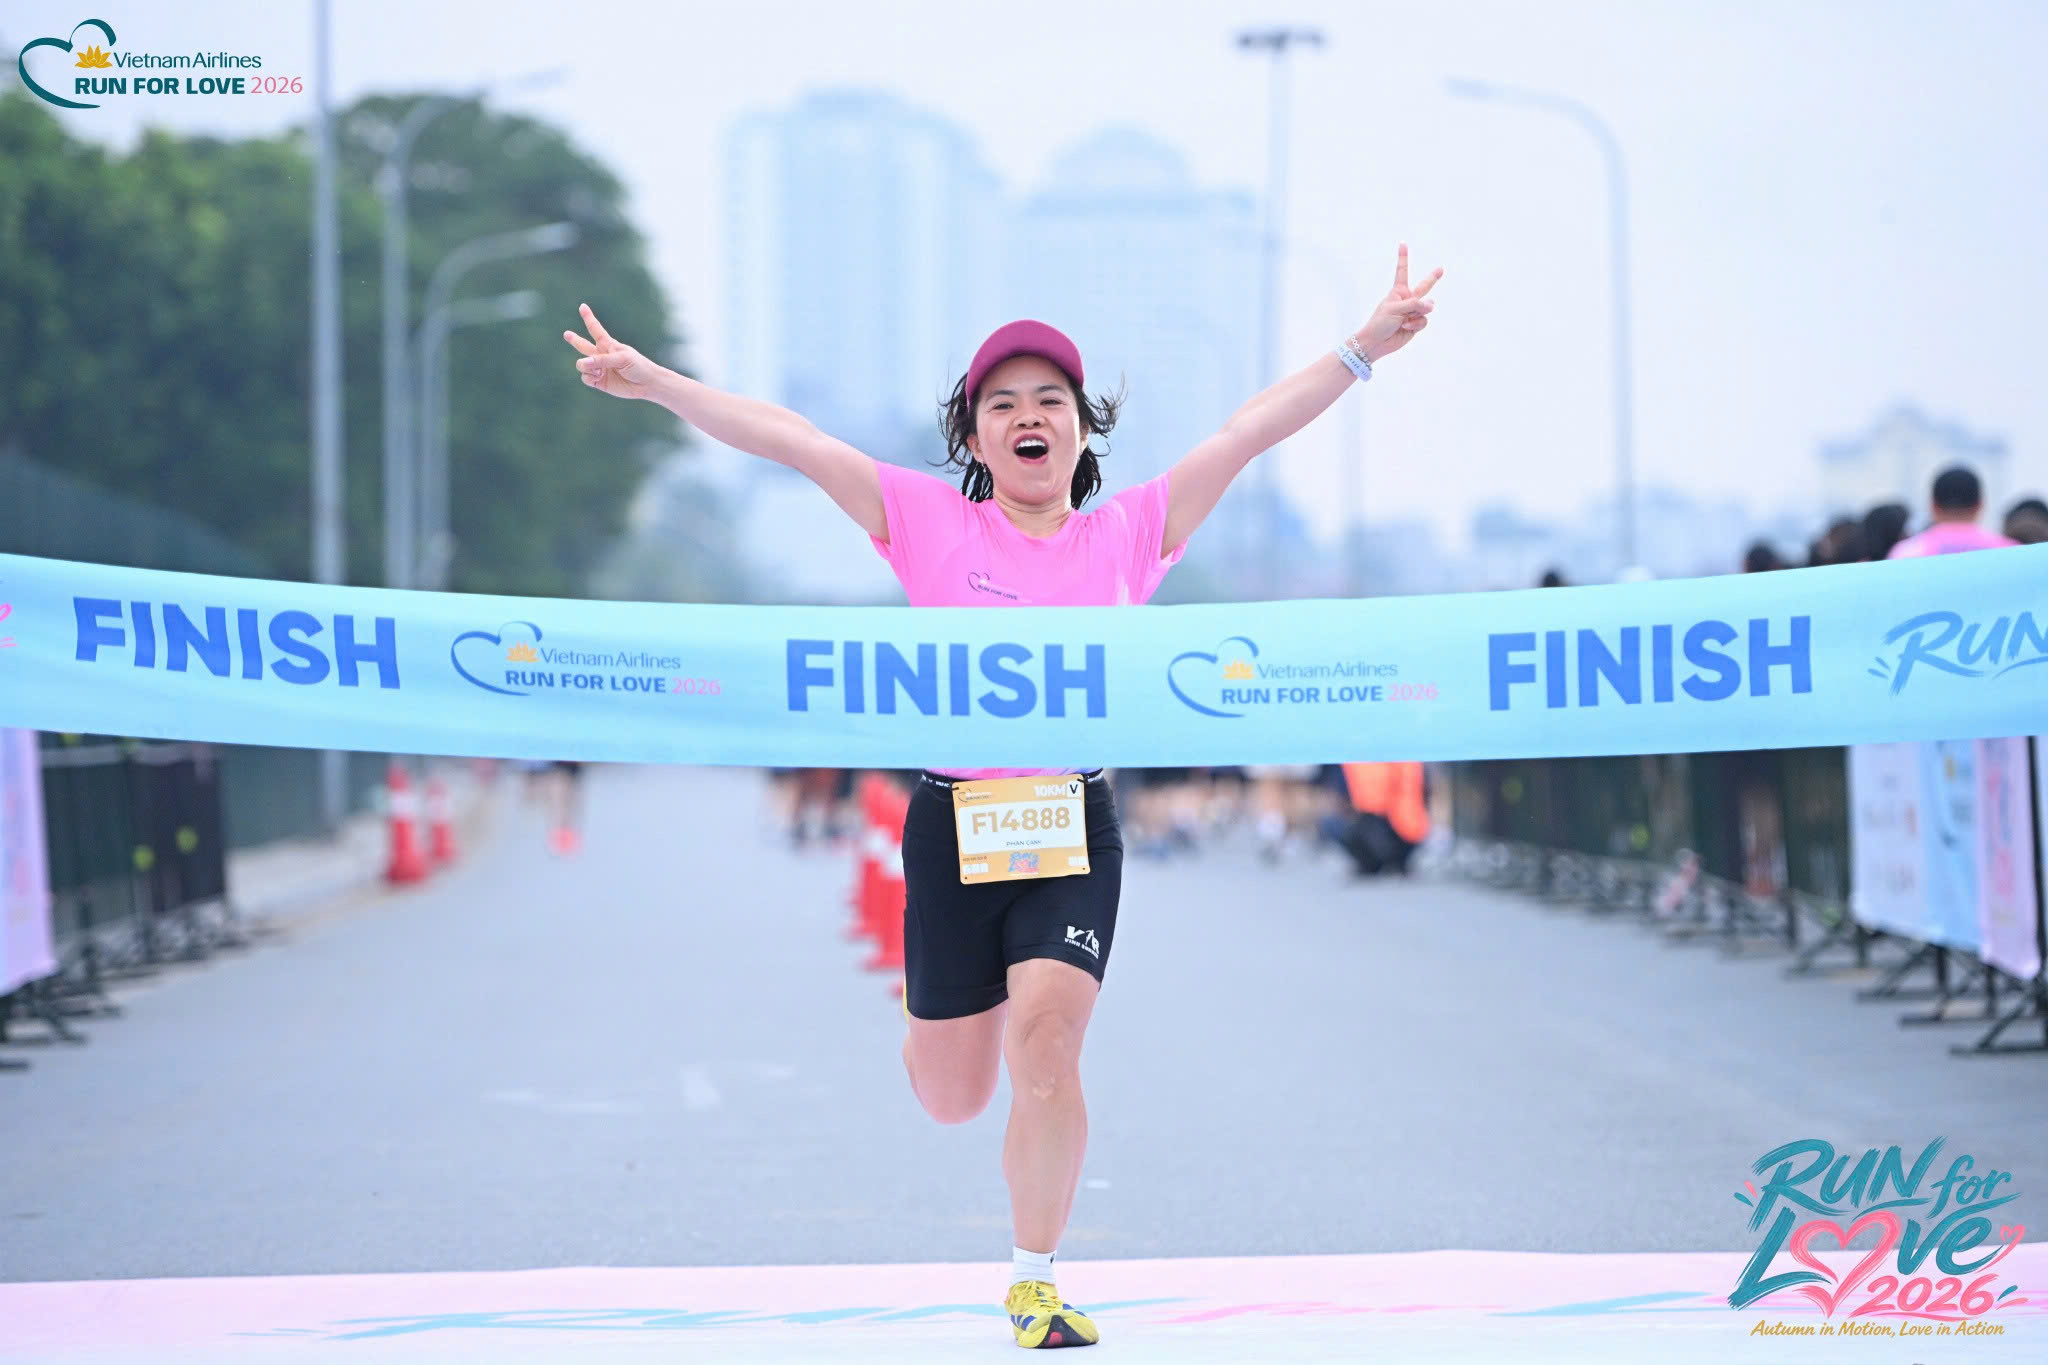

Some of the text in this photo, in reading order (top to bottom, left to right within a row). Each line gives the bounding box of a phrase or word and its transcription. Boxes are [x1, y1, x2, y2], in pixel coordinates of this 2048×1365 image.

[73, 596, 401, 690] FINISH
[540, 647, 682, 670] Vietnam Airlines
[1256, 660, 1399, 680] Vietnam Airlines
[1488, 615, 1812, 711] FINISH
[505, 670, 722, 696] RUN FOR LOVE 2026
[786, 639, 1107, 719] FINISH
[1221, 682, 1440, 705] RUN FOR LOVE 2026
[1033, 783, 1079, 798] 10KM V
[972, 806, 1071, 835] F14888
